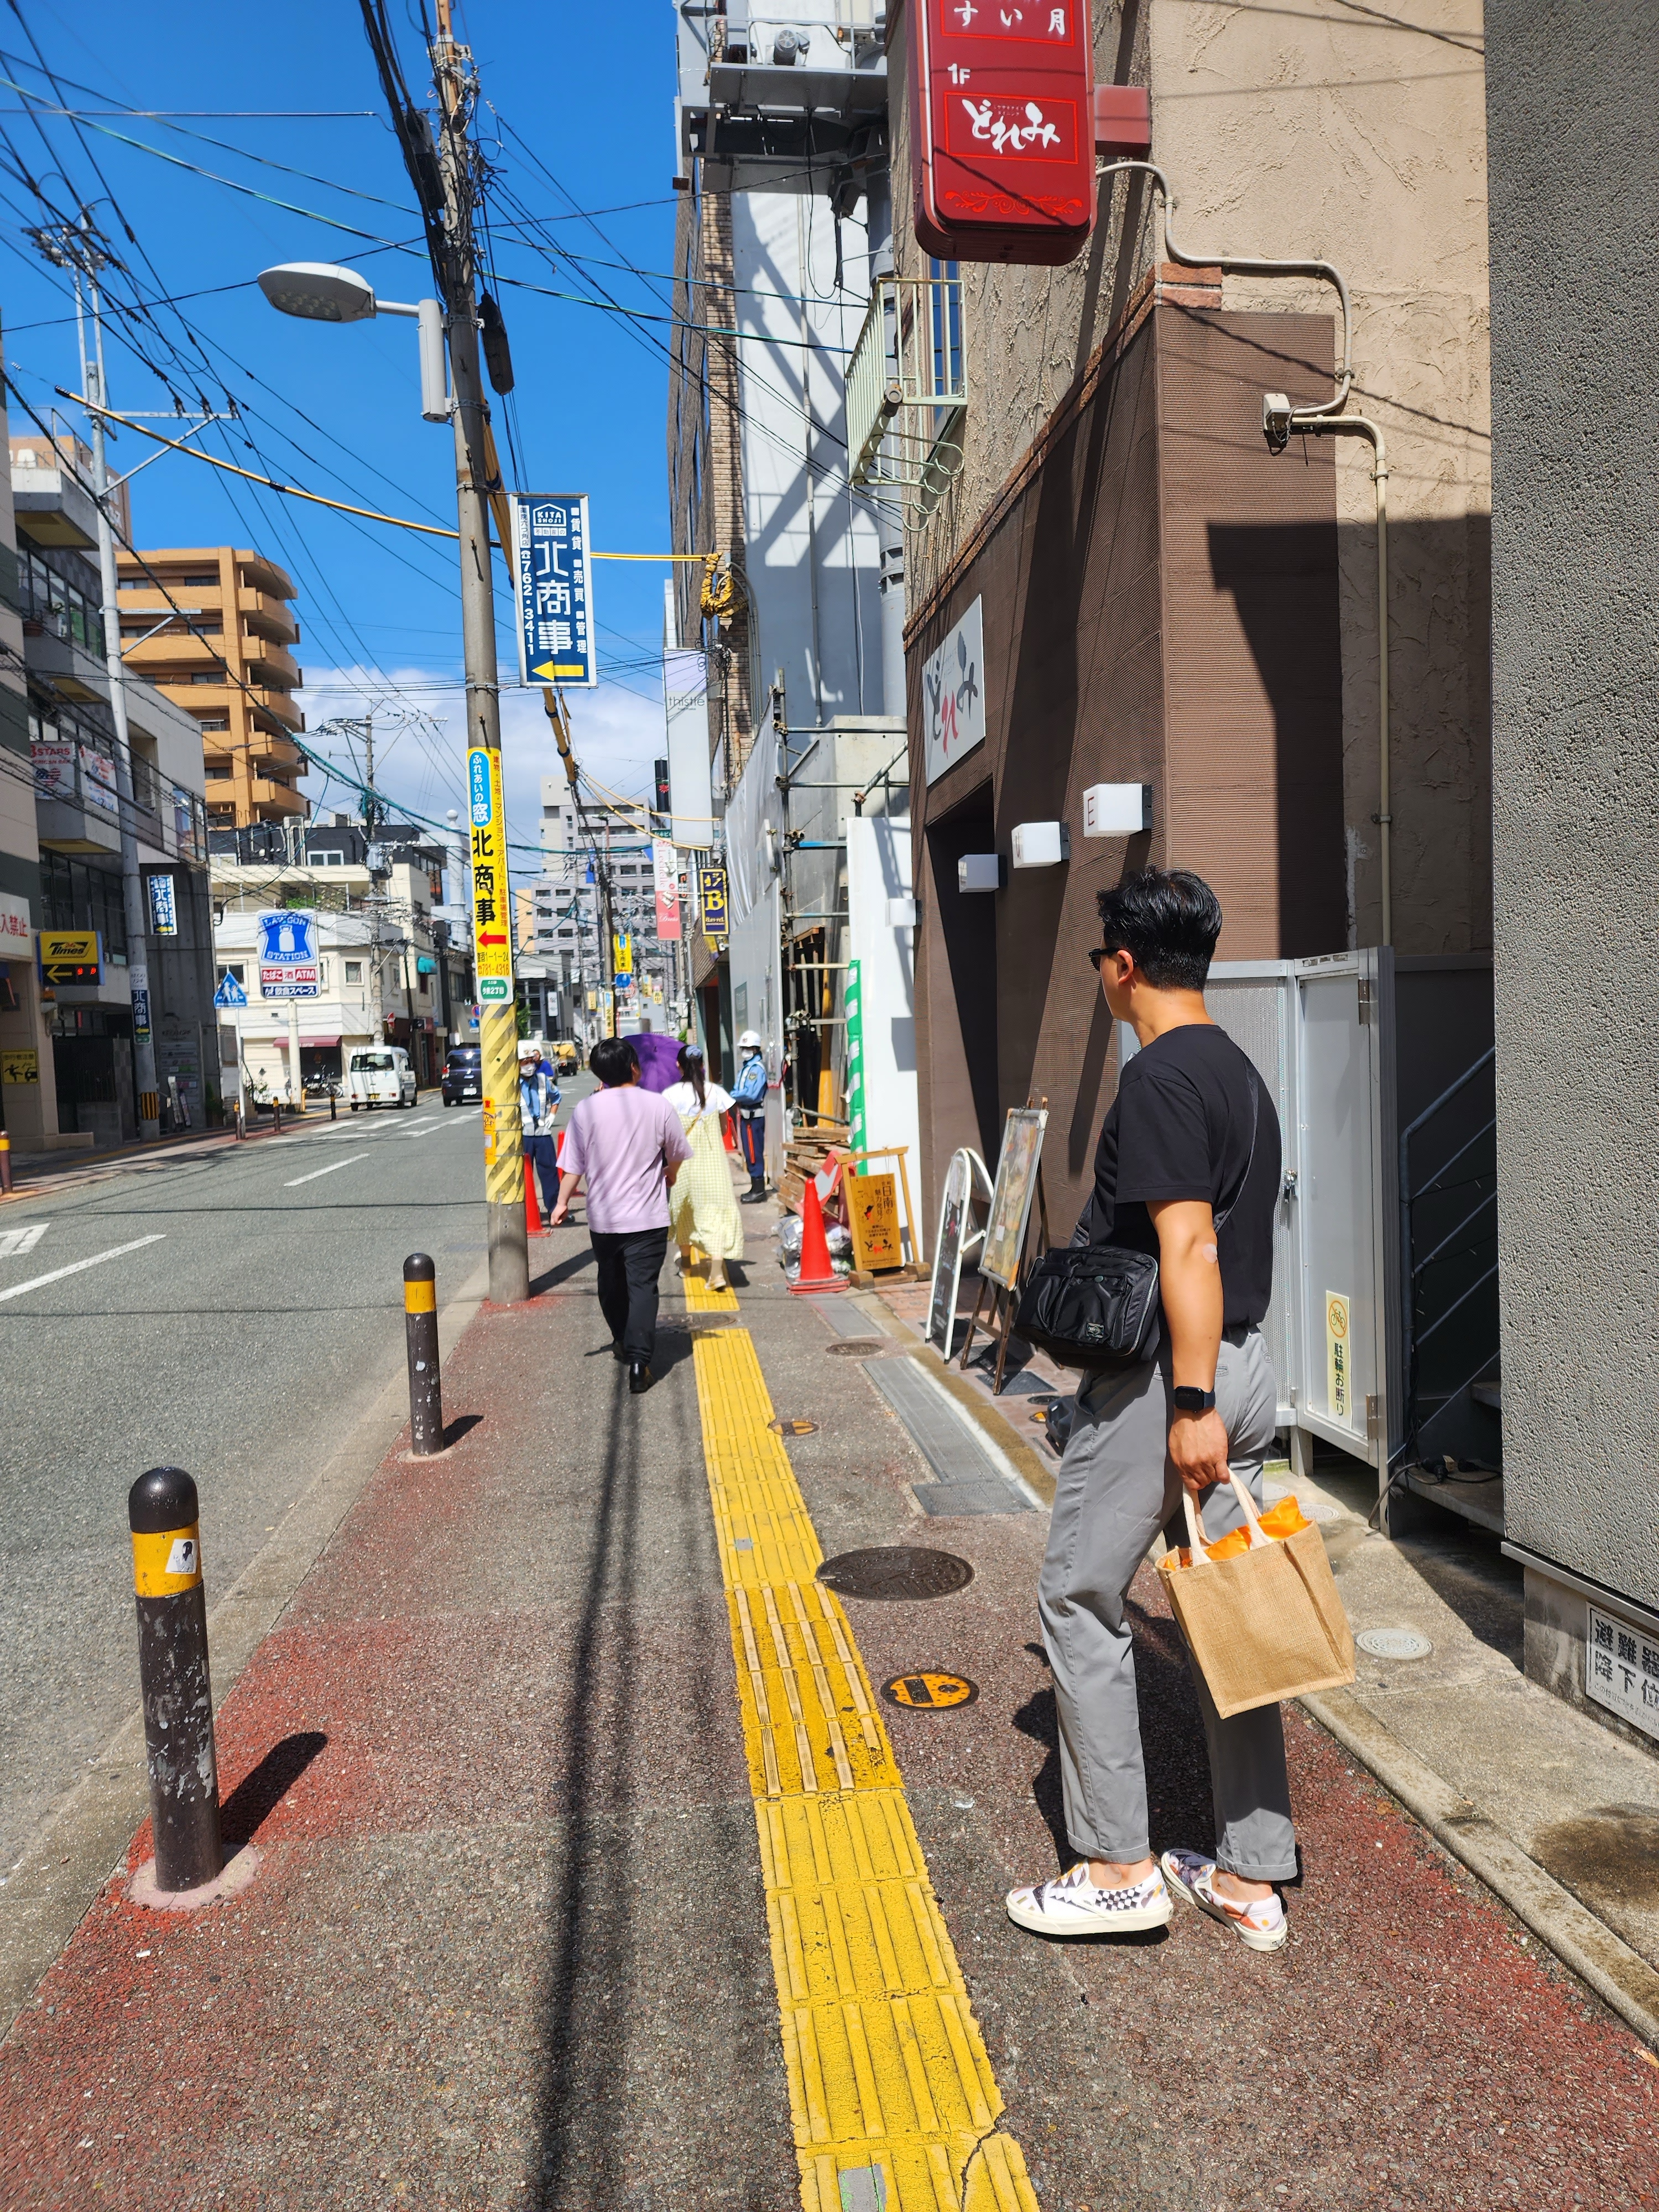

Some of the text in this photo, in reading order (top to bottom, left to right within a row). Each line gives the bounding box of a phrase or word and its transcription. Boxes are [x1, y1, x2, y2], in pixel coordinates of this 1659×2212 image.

[947, 63, 971, 84] 1F
[962, 99, 1061, 154] どれみ
[534, 541, 573, 655] 北商事
[668, 696, 705, 706] thistle
[38, 748, 70, 756] STARS
[473, 754, 488, 823] ふれあいの窓
[472, 829, 496, 926] 北商事
[50, 946, 85, 956] Times
[266, 950, 309, 961] STATION
[263, 971, 283, 980] たばこ
[296, 970, 316, 980] ATM
[275, 987, 316, 995] 飲食スペース
[482, 987, 504, 995] 今泉2丁目
[1334, 1342, 1344, 1416] 駐輪お断り
